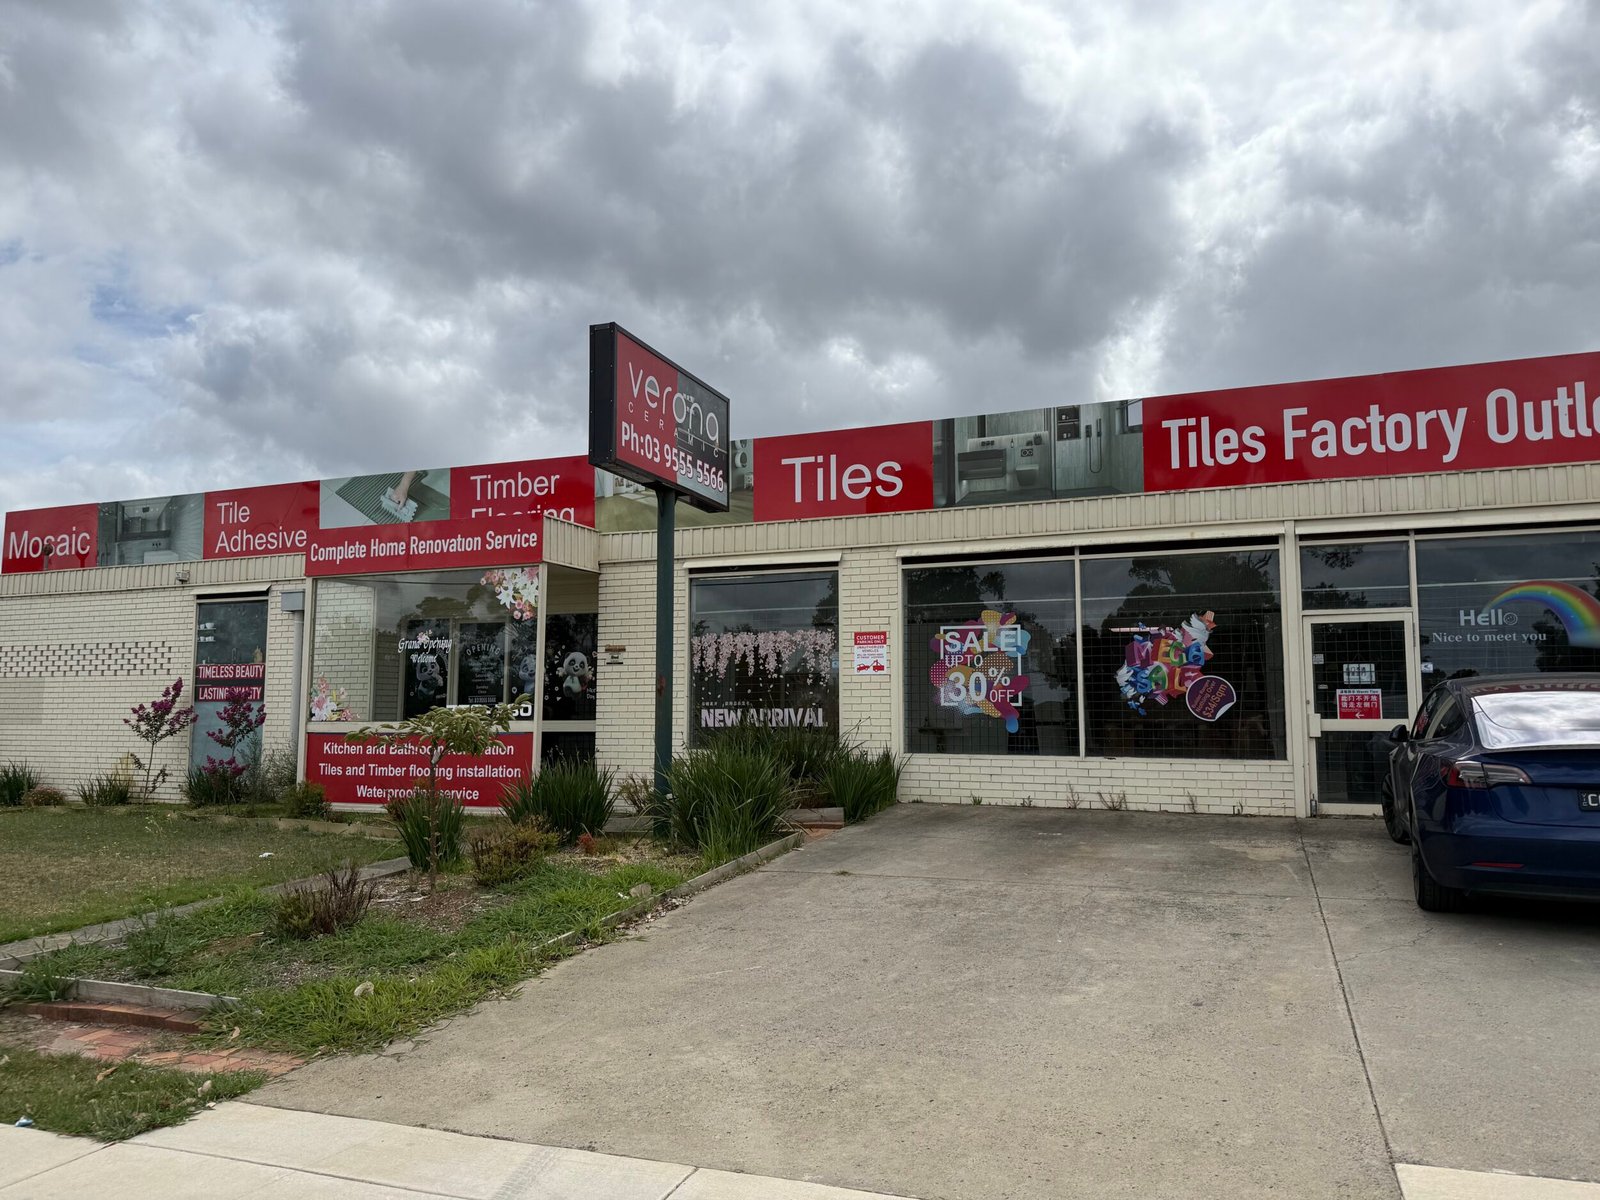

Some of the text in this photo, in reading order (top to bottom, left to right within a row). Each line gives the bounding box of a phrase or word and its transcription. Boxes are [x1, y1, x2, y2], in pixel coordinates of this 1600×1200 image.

[1161, 416, 1266, 470] Tiles
[1283, 404, 1468, 463] Factory
[621, 421, 724, 492] Ph:03 9555 5566
[470, 472, 560, 500] Timber
[781, 454, 903, 503] Tiles
[217, 501, 250, 525] Tile
[9, 526, 90, 559] Mosaic
[215, 526, 307, 553] Adhesive
[310, 528, 538, 565] Complete Home Renovation Service
[944, 630, 1017, 653] SALE
[1432, 632, 1547, 644] Nice to meet you
[199, 665, 264, 678] TIMELESS BEAUTY
[989, 689, 1015, 703] OFF
[701, 707, 828, 727] NEW ARRIVAL
[323, 742, 363, 754] Kitchen
[366, 743, 386, 755] and
[318, 763, 521, 780] Tiles and Timber flooing installation
[1588, 794, 1600, 806] C
